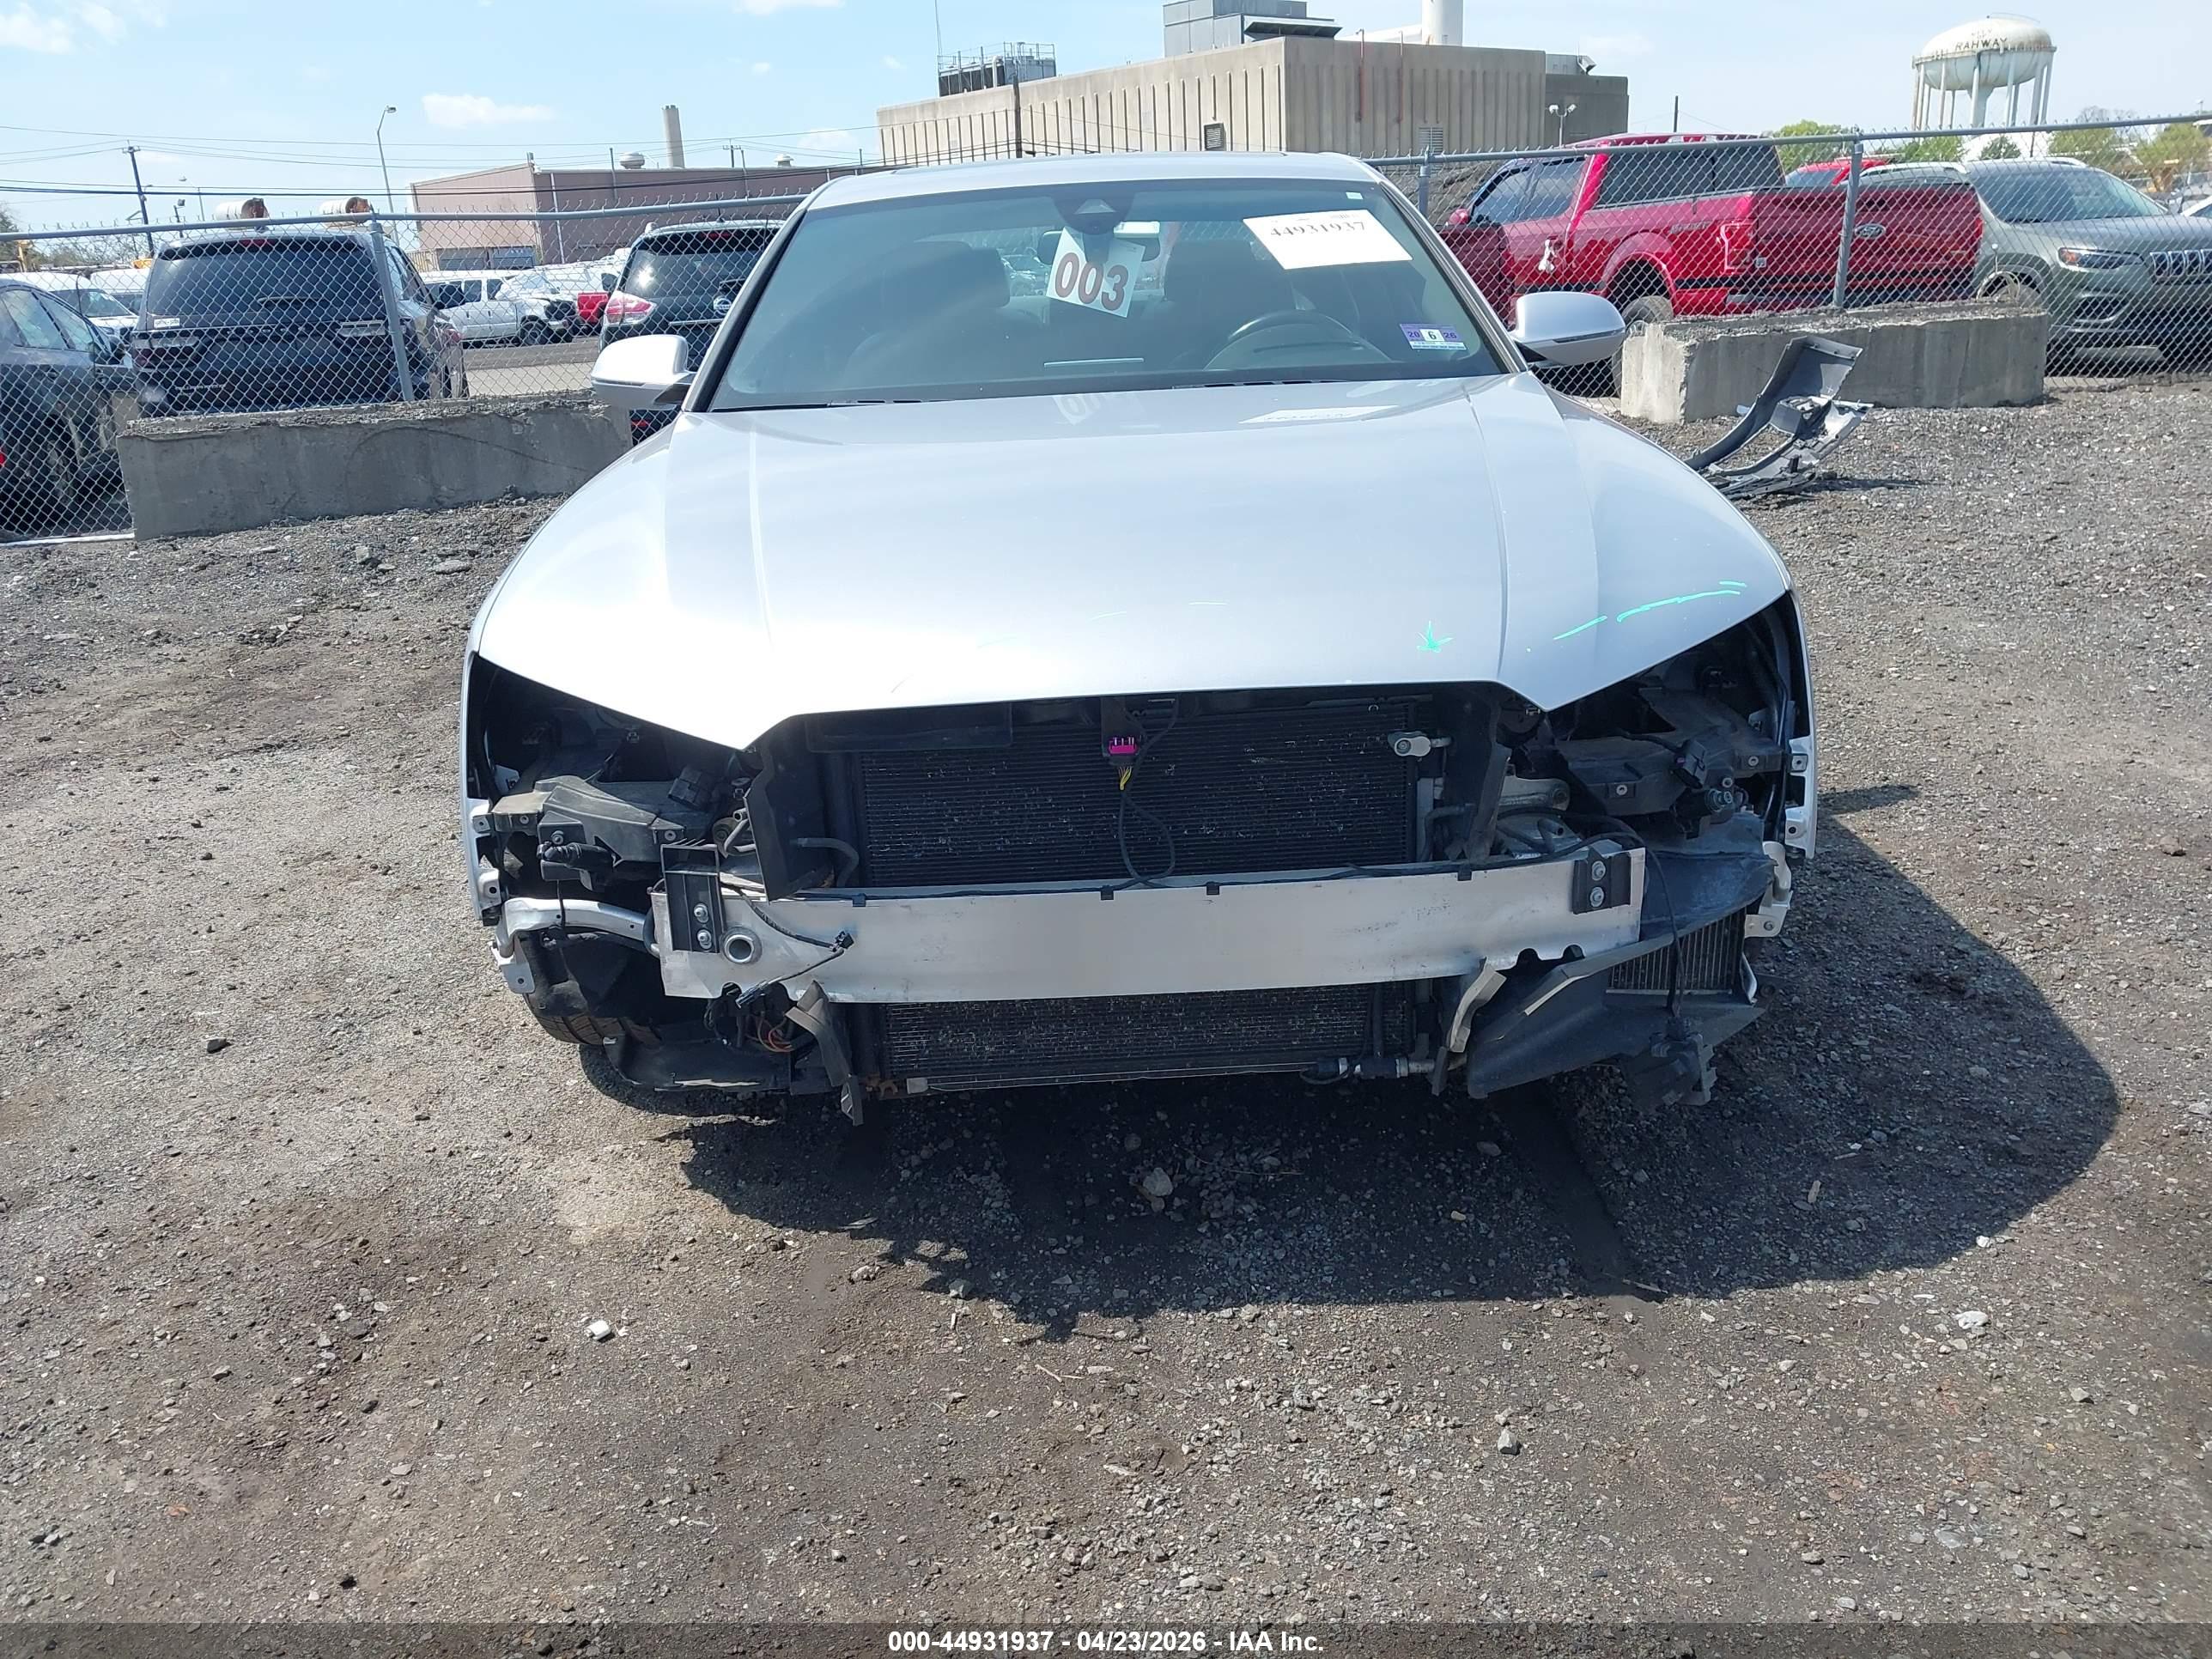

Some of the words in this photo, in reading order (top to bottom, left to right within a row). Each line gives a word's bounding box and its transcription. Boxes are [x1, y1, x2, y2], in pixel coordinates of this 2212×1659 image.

[1955, 37, 2008, 51] RAHWAY
[1270, 221, 1365, 237] 44931937
[1054, 252, 1129, 311] 003
[1427, 331, 1437, 340] 6
